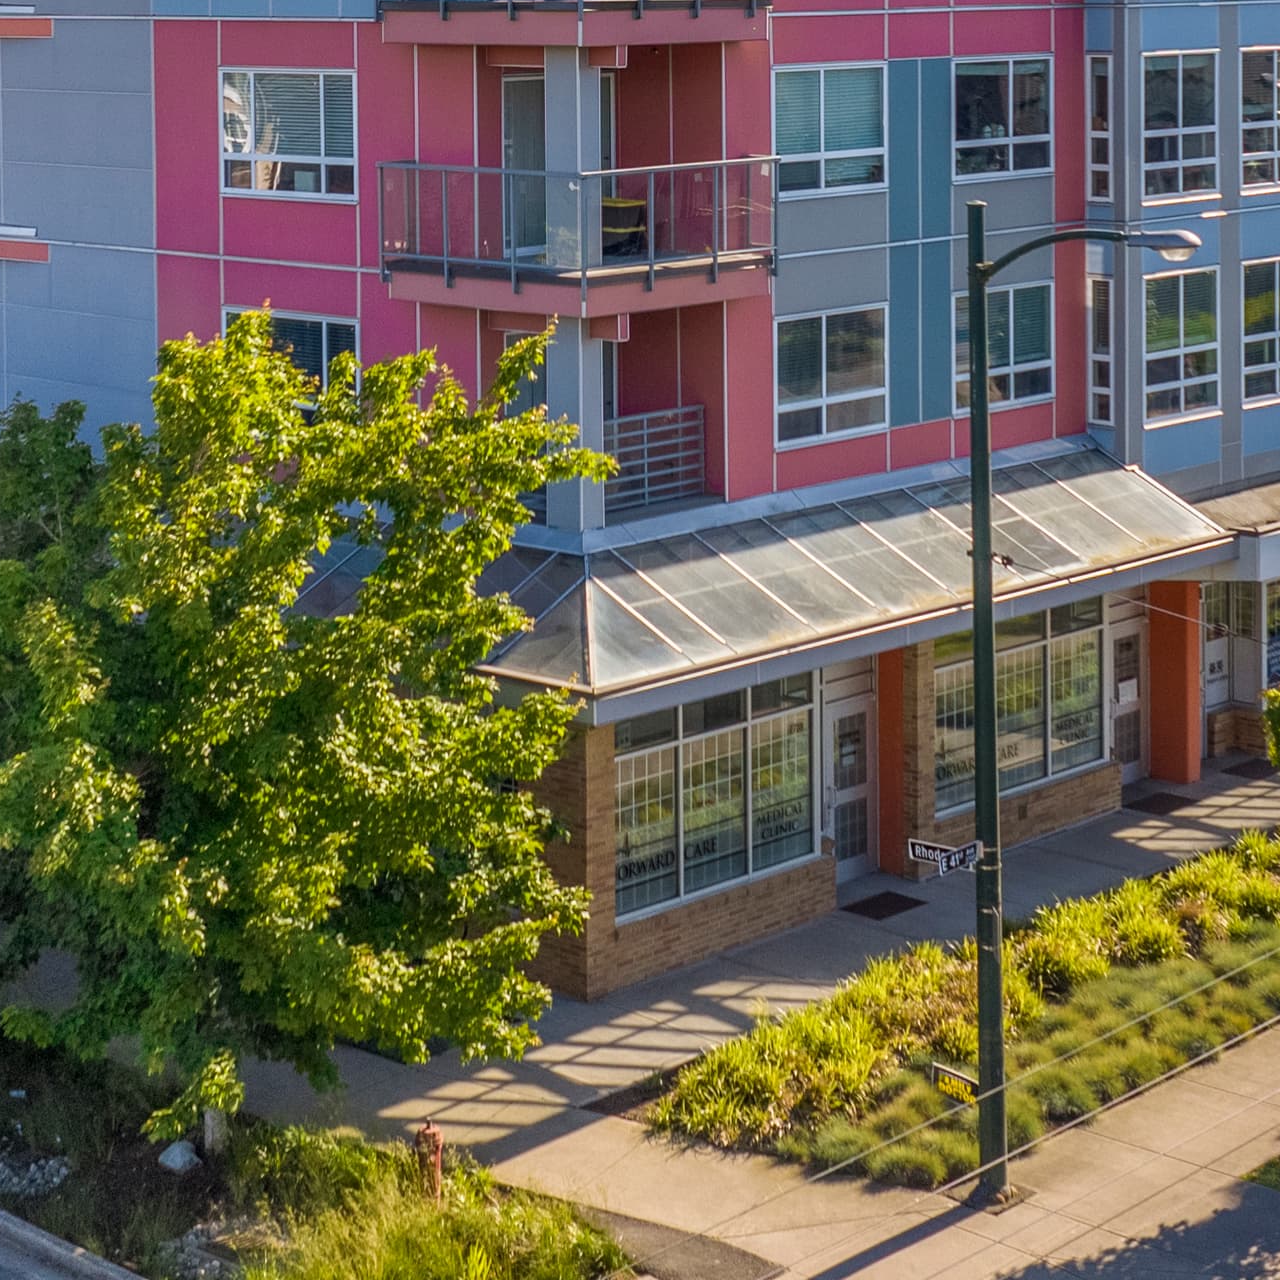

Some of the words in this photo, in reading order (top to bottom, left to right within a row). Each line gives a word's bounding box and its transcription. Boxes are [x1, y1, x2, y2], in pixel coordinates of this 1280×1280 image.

[935, 758, 975, 781] ORWAR
[1000, 743, 1019, 761] ARE
[757, 802, 802, 827] MEDICAL
[761, 819, 801, 840] CLINIC
[617, 849, 675, 881] ORWARD
[684, 837, 717, 860] CARE
[915, 845, 941, 861] Rhod
[942, 858, 948, 872] E
[938, 1081, 976, 1104] DOCTOR
